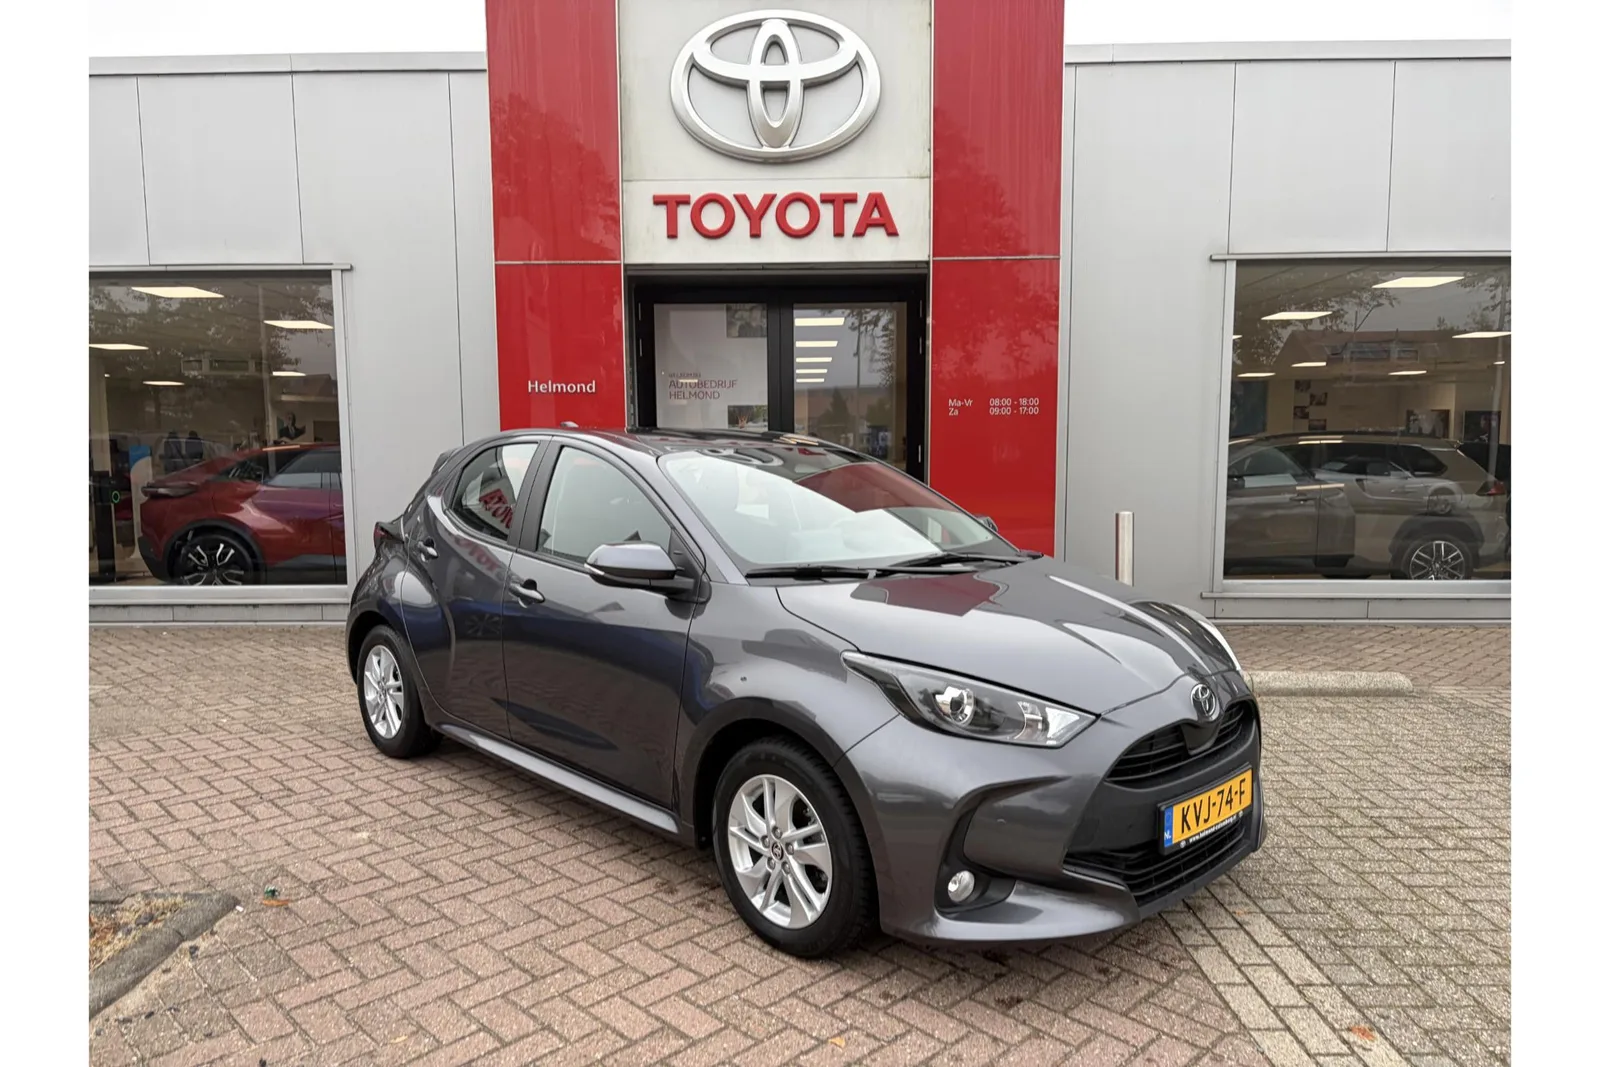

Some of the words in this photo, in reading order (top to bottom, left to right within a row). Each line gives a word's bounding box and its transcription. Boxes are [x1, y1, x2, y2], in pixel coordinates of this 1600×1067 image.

[653, 192, 899, 239] TOYOTA
[528, 380, 596, 393] Helmond
[669, 380, 738, 389] AUTOBEDRIJF
[669, 390, 721, 400] HELMOND
[948, 399, 973, 407] Ma-Vr
[989, 398, 1012, 406] 08:00
[1019, 398, 1039, 406] 18:00
[948, 407, 959, 416] Za
[989, 407, 1012, 415] 09:00
[1019, 406, 1039, 415] 17:00
[1181, 778, 1246, 834] KVJ-74-F
[1164, 829, 1172, 840] NL
